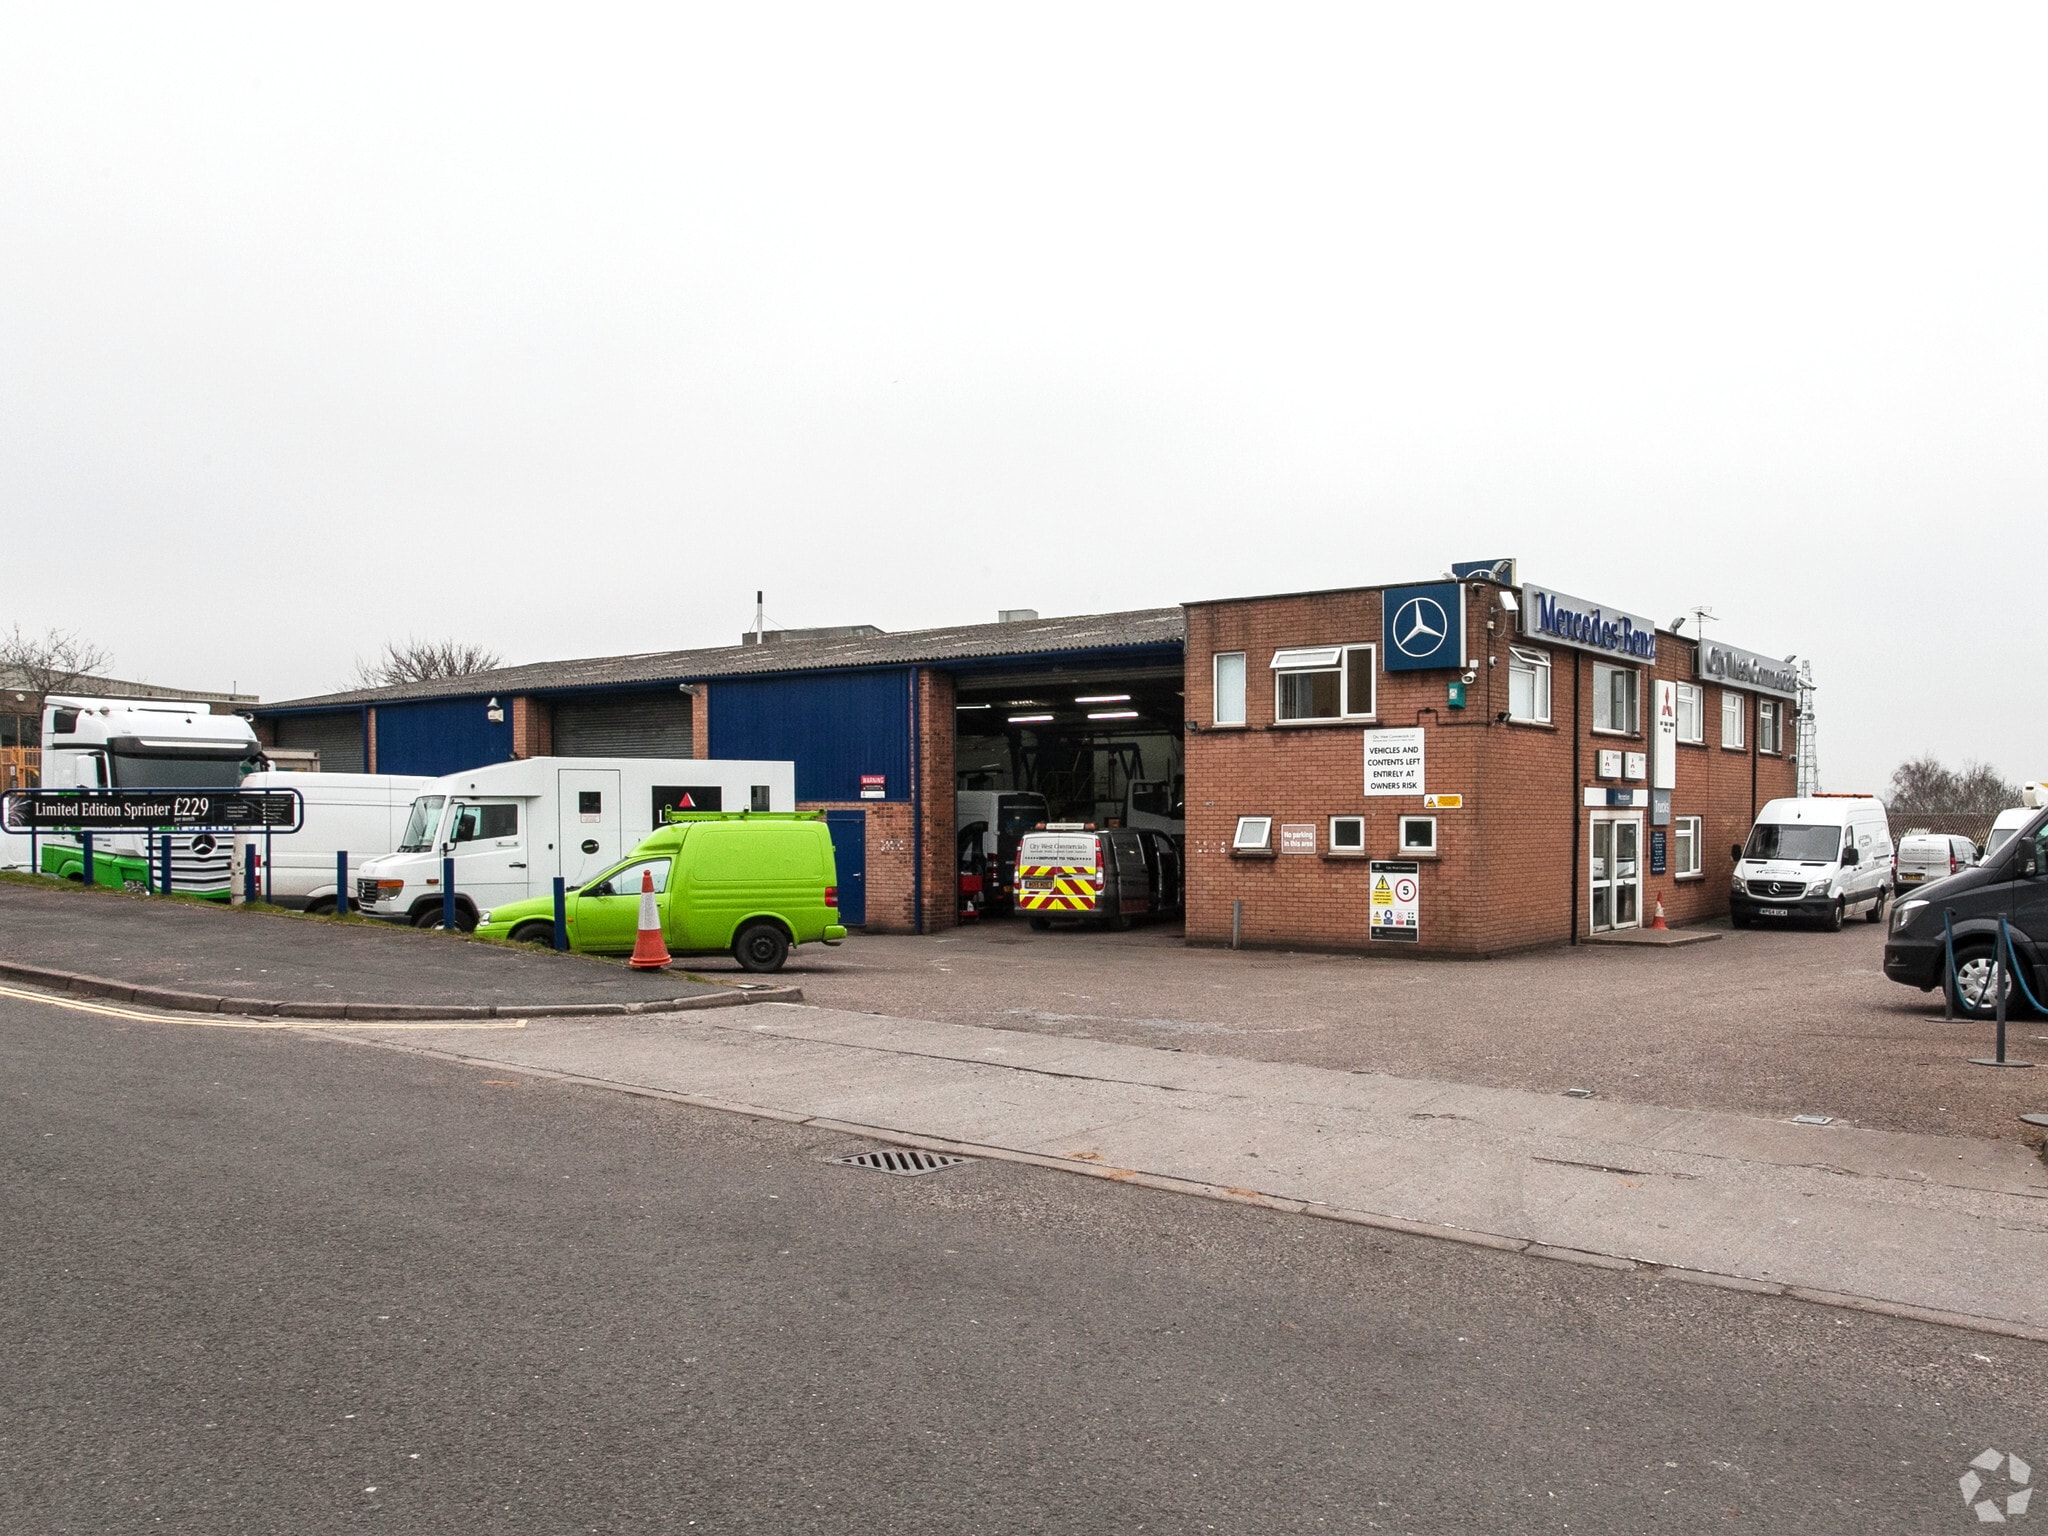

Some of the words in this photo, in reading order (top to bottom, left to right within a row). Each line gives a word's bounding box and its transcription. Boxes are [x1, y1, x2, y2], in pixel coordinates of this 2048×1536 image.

[1537, 592, 1656, 659] Mercedes-Benz
[1725, 652, 1749, 682] West
[1369, 746, 1400, 754] VEHICLES
[1367, 758, 1404, 766] CONTENTS
[1373, 770, 1403, 778] ENTIRELY
[35, 802, 79, 816] Limited
[81, 802, 121, 816] Edition
[124, 802, 171, 820] Sprinter
[174, 797, 209, 816] £229
[1292, 831, 1313, 840] parking
[1402, 885, 1409, 895] 5
